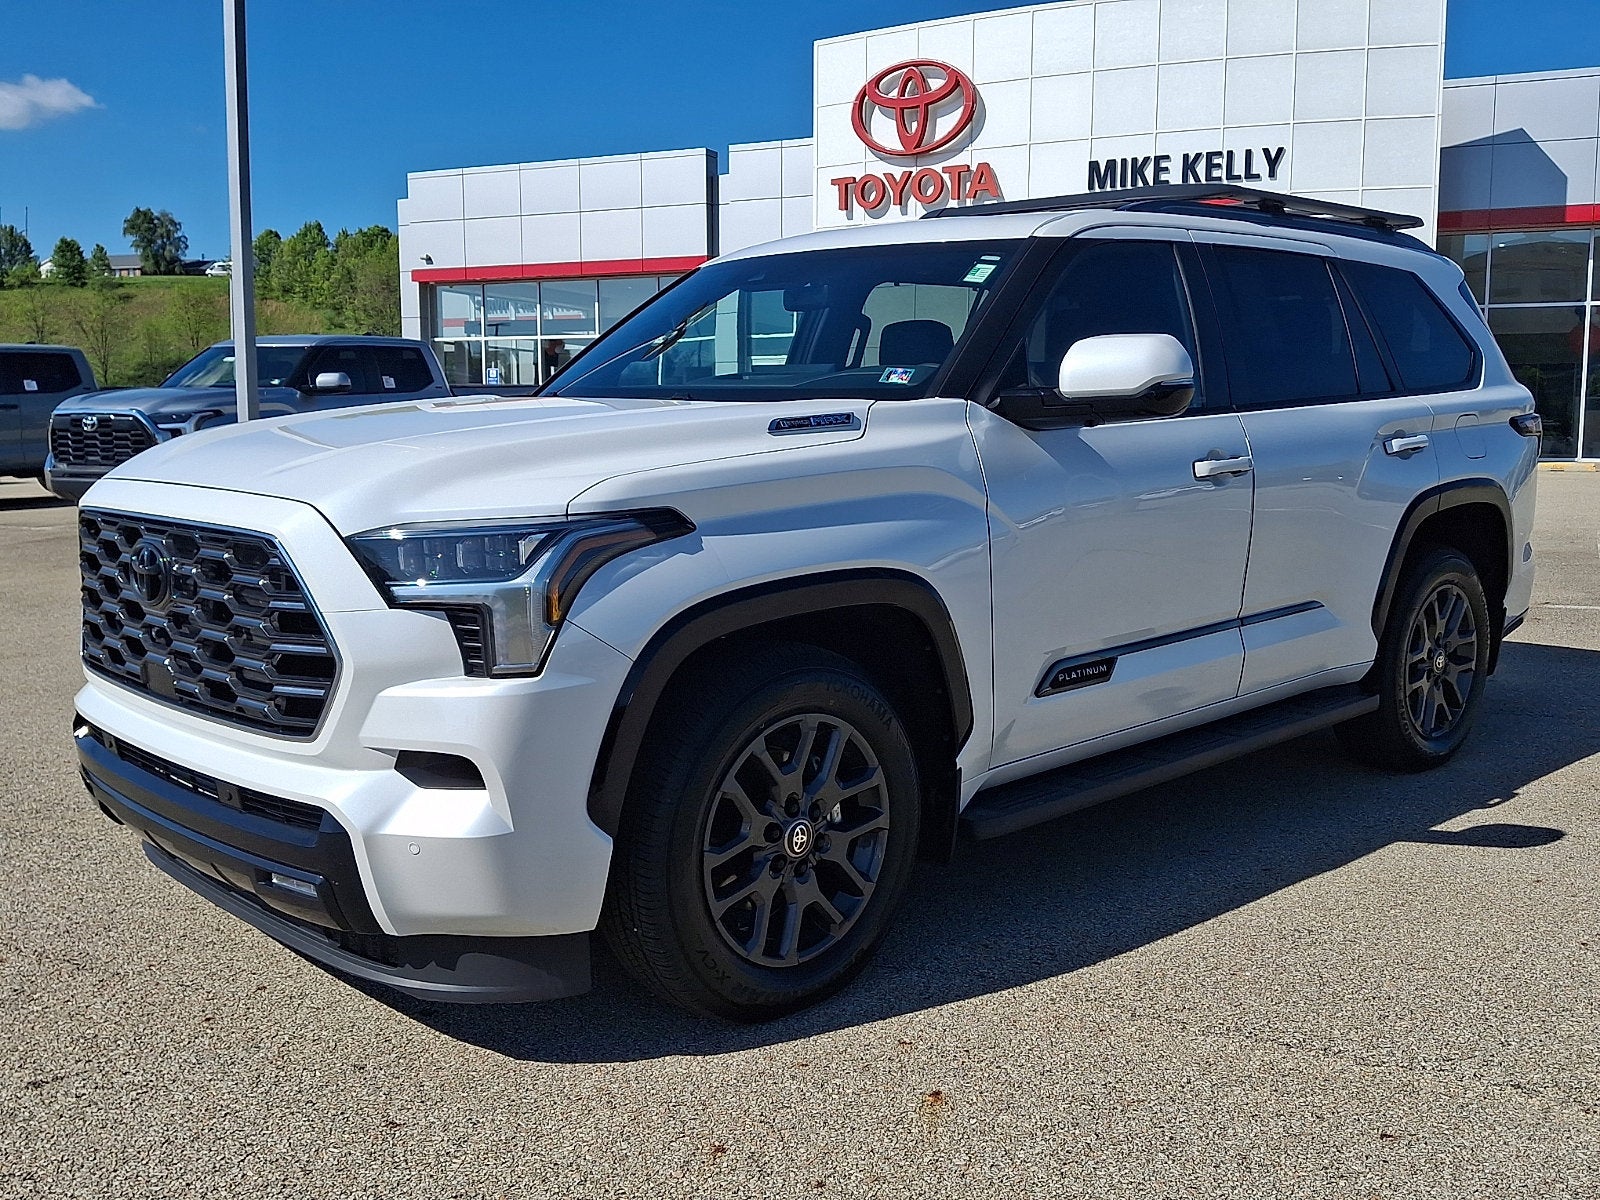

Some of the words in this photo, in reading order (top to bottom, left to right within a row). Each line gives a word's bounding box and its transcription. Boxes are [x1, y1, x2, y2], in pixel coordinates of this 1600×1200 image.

[832, 163, 1000, 211] TOYOTA
[1088, 154, 1171, 191] MIKE
[1181, 147, 1285, 184] KELLY
[1058, 664, 1107, 682] PLATINUM
[823, 679, 896, 731] YOKOHAMA
